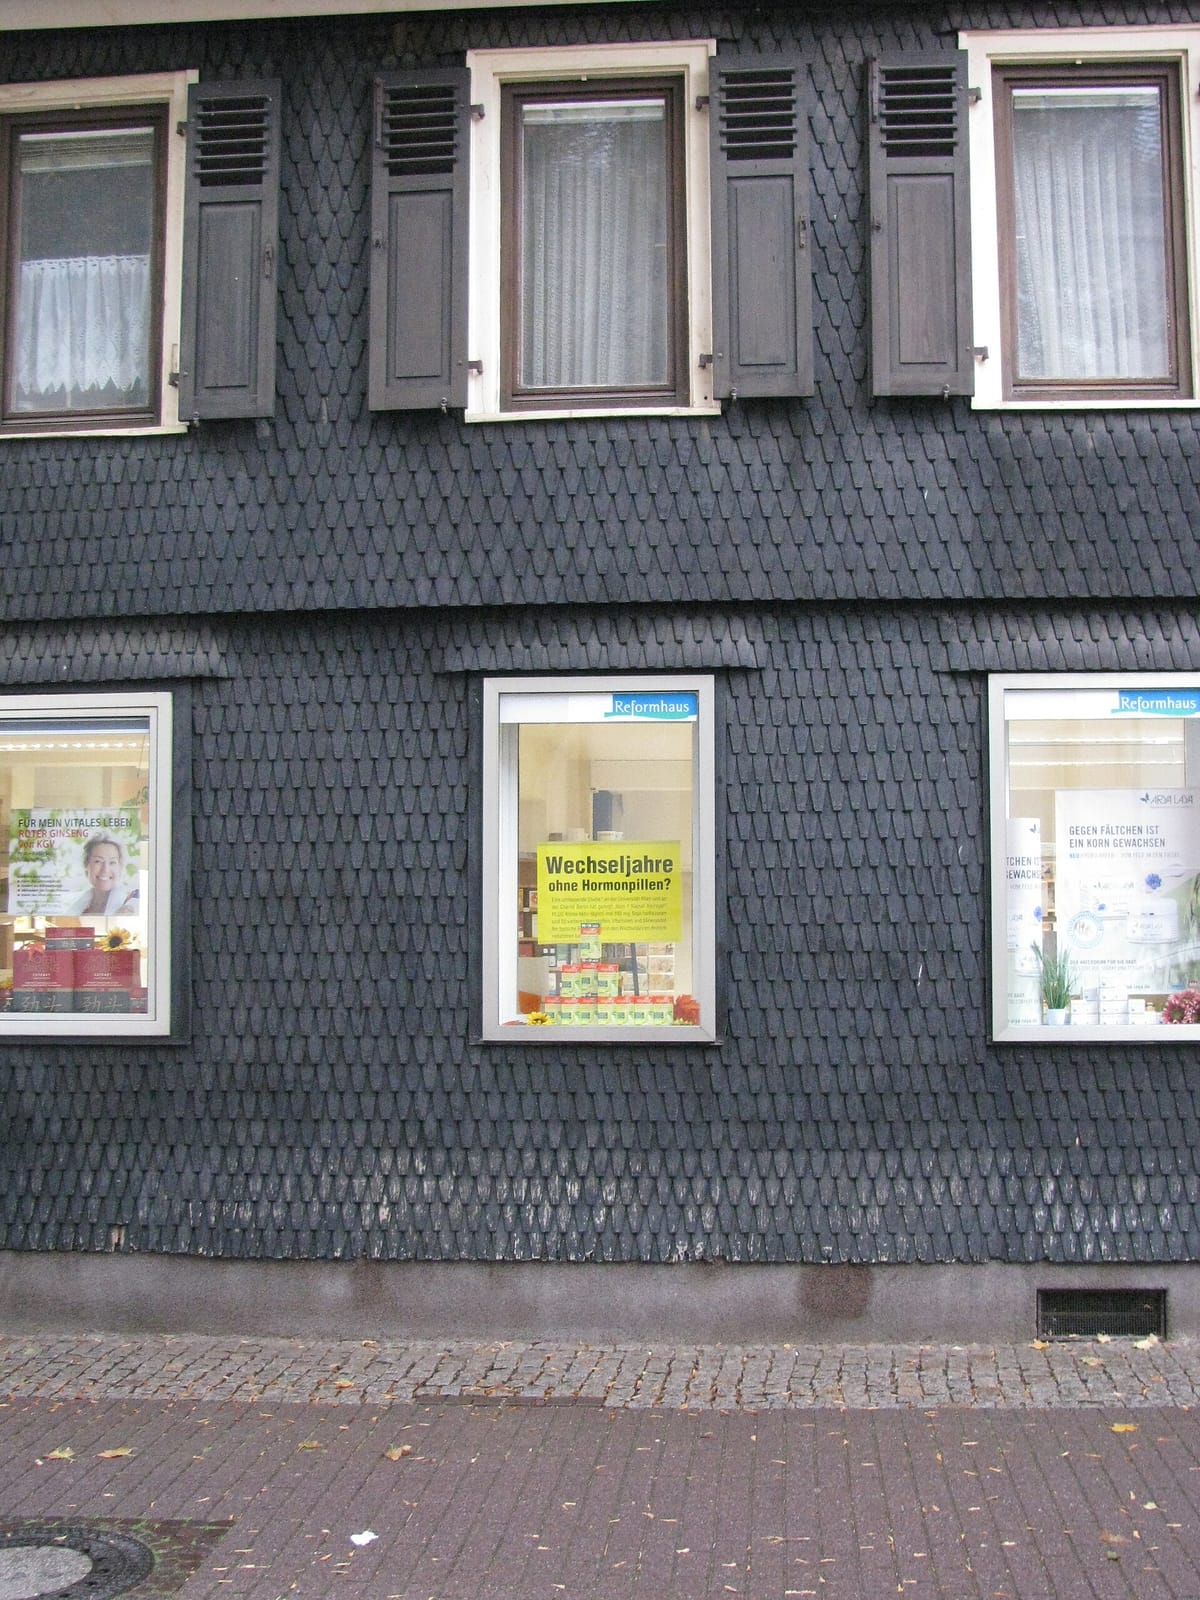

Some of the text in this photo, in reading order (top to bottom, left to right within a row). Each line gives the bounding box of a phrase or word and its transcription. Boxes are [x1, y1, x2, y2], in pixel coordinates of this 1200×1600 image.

[615, 700, 690, 716] Reformhaus
[1121, 696, 1197, 712] Reformhaus
[18, 818, 132, 828] FÜR MEIN VITALES LEBEN
[19, 829, 89, 838] ROTER GINSENG
[1069, 824, 1159, 836] GEGEN FÄLTCHEN IST
[36, 840, 55, 848] KGV
[1069, 838, 1166, 848] EIN KORN GEWACHSEN
[546, 856, 673, 877] Wechseljahre
[548, 878, 671, 893] ohne Hormonpillen?
